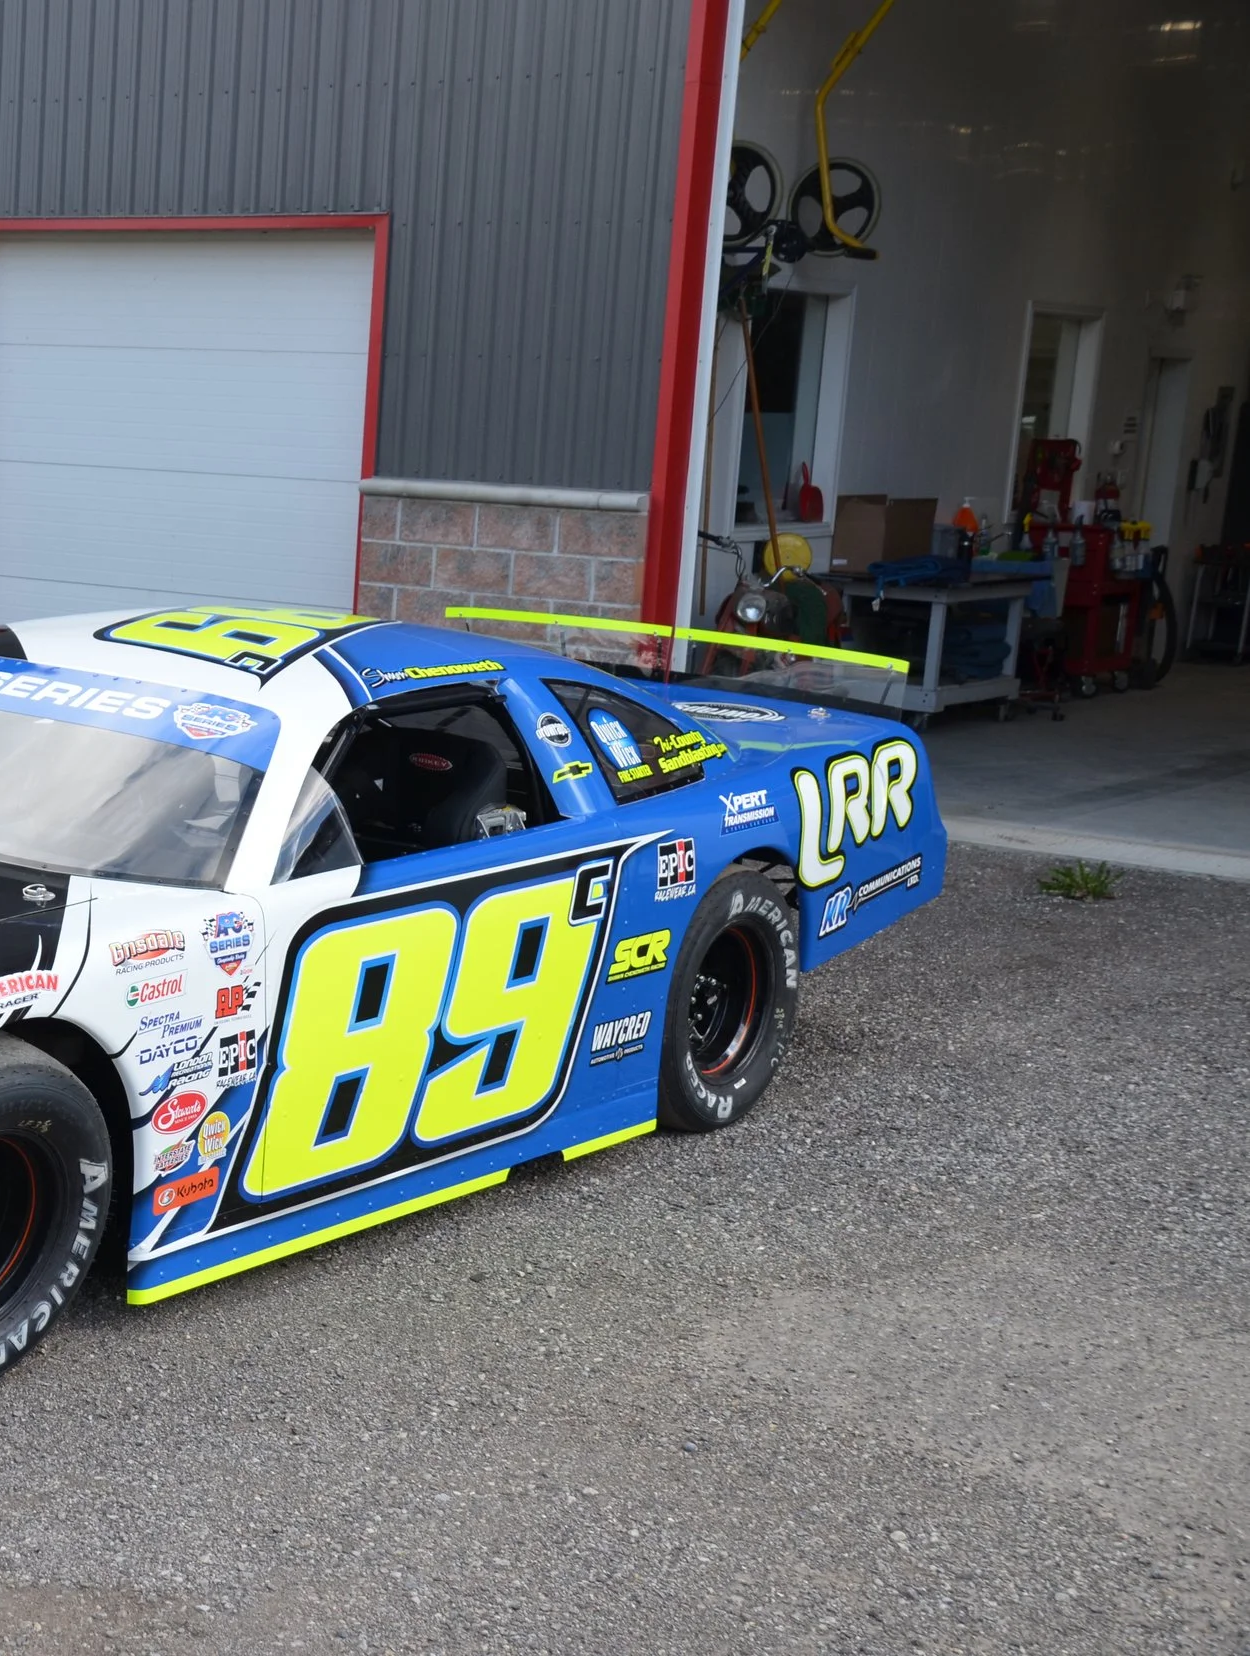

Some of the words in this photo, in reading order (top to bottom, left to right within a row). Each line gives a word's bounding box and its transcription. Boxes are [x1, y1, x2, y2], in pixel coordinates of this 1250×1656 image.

[404, 660, 505, 679] Chenoweth
[182, 714, 238, 731] SERIES
[718, 789, 767, 818] XPERT
[724, 806, 775, 828] TRANSMISSION
[794, 740, 917, 888] LRR
[659, 849, 694, 878] EPIC
[858, 856, 921, 897] COMMUNICATIONS
[209, 934, 251, 954] SERIES
[608, 928, 671, 976] SCR
[729, 889, 798, 989] AMERICAN
[115, 962, 144, 976] RACING
[144, 953, 185, 968] PRODUCTS
[140, 974, 183, 1003] Castrol
[139, 1011, 180, 1031] SPECTRA
[161, 1018, 203, 1039] PREMIUM
[591, 1011, 652, 1052] WAYCRED
[139, 1035, 198, 1065] DAYCO
[242, 876, 599, 1196] 89
[218, 1038, 257, 1069] EPIC
[154, 1144, 192, 1163] INTERSTATE
[154, 1153, 188, 1170] BATTERIES
[177, 1177, 214, 1198] Kubota
